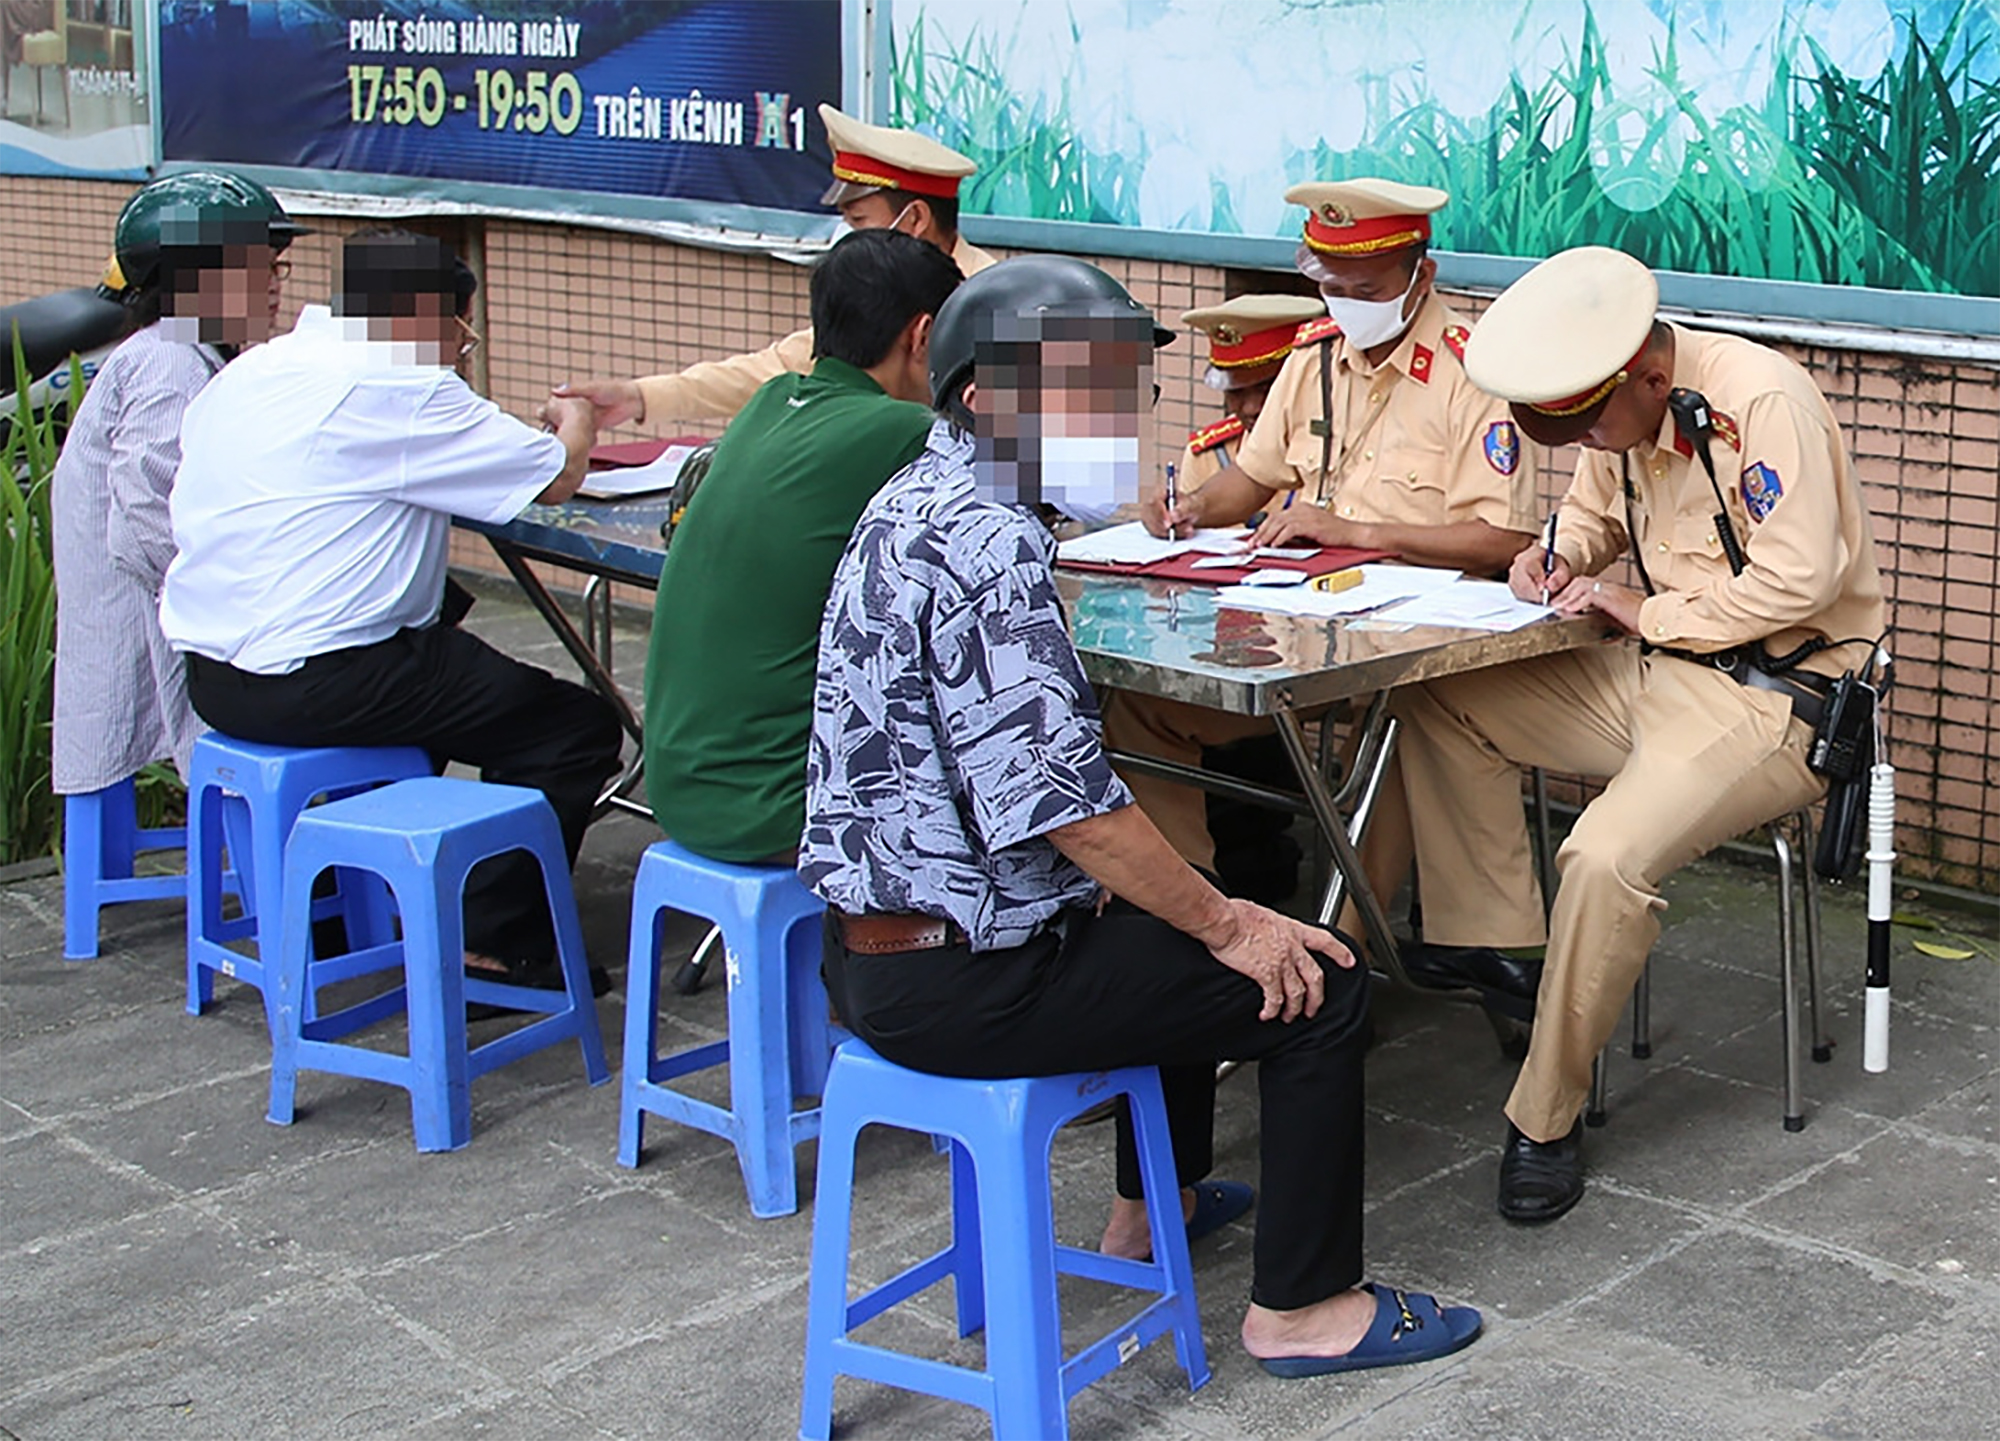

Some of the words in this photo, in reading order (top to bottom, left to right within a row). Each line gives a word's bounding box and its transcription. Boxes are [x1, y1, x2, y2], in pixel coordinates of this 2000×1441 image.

[350, 14, 398, 51] PHÁT
[402, 14, 457, 53] SÓNG
[461, 15, 517, 55] HÀNG
[522, 16, 580, 57] NGÀY
[348, 65, 446, 127] 17:50
[454, 95, 467, 110] -
[475, 69, 583, 135] 19:50
[594, 86, 661, 140] TRÊN
[670, 89, 743, 145] KÊNH
